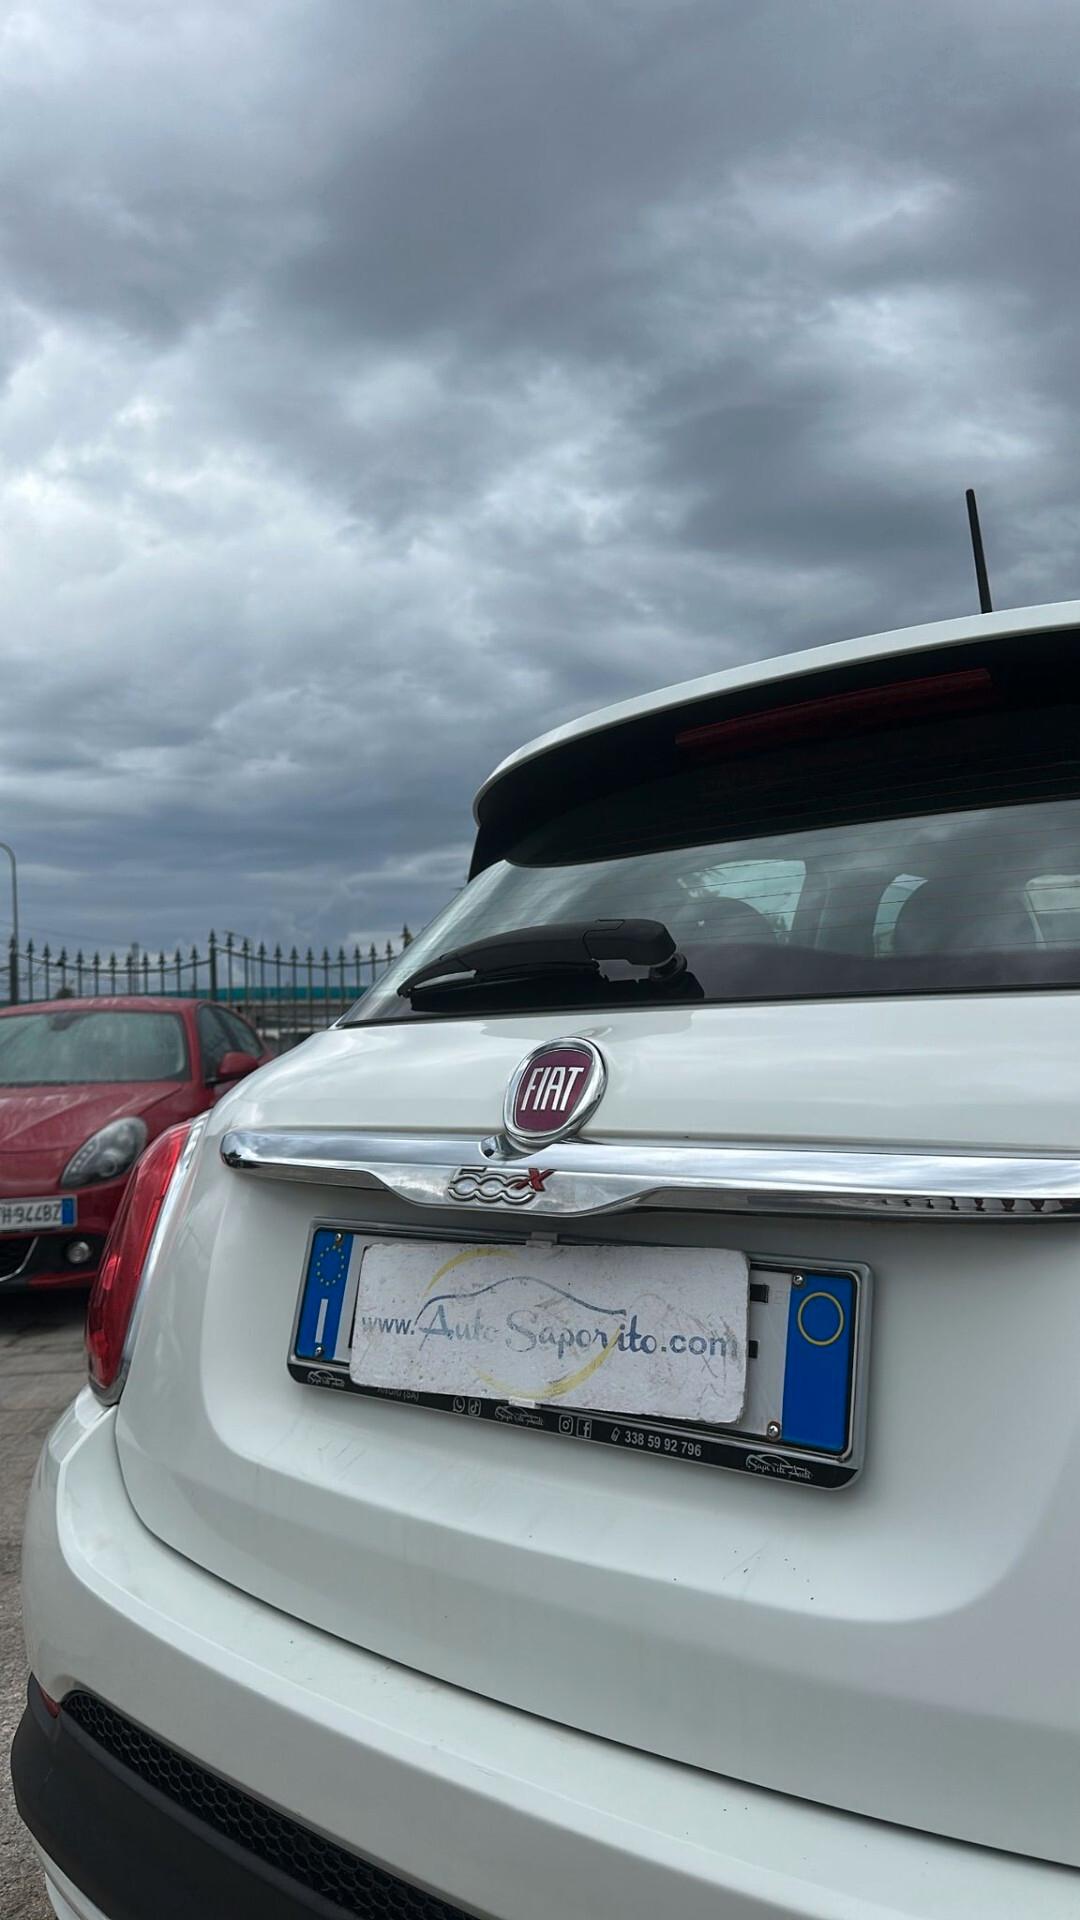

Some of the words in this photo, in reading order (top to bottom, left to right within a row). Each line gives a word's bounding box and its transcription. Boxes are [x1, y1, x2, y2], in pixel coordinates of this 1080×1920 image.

[520, 1067, 585, 1112] FIAT
[0, 1203, 61, 1225] H944BZ
[624, 1430, 645, 1446] 338
[647, 1435, 661, 1449] 59
[664, 1438, 678, 1452] 92
[681, 1441, 702, 1457] 796
